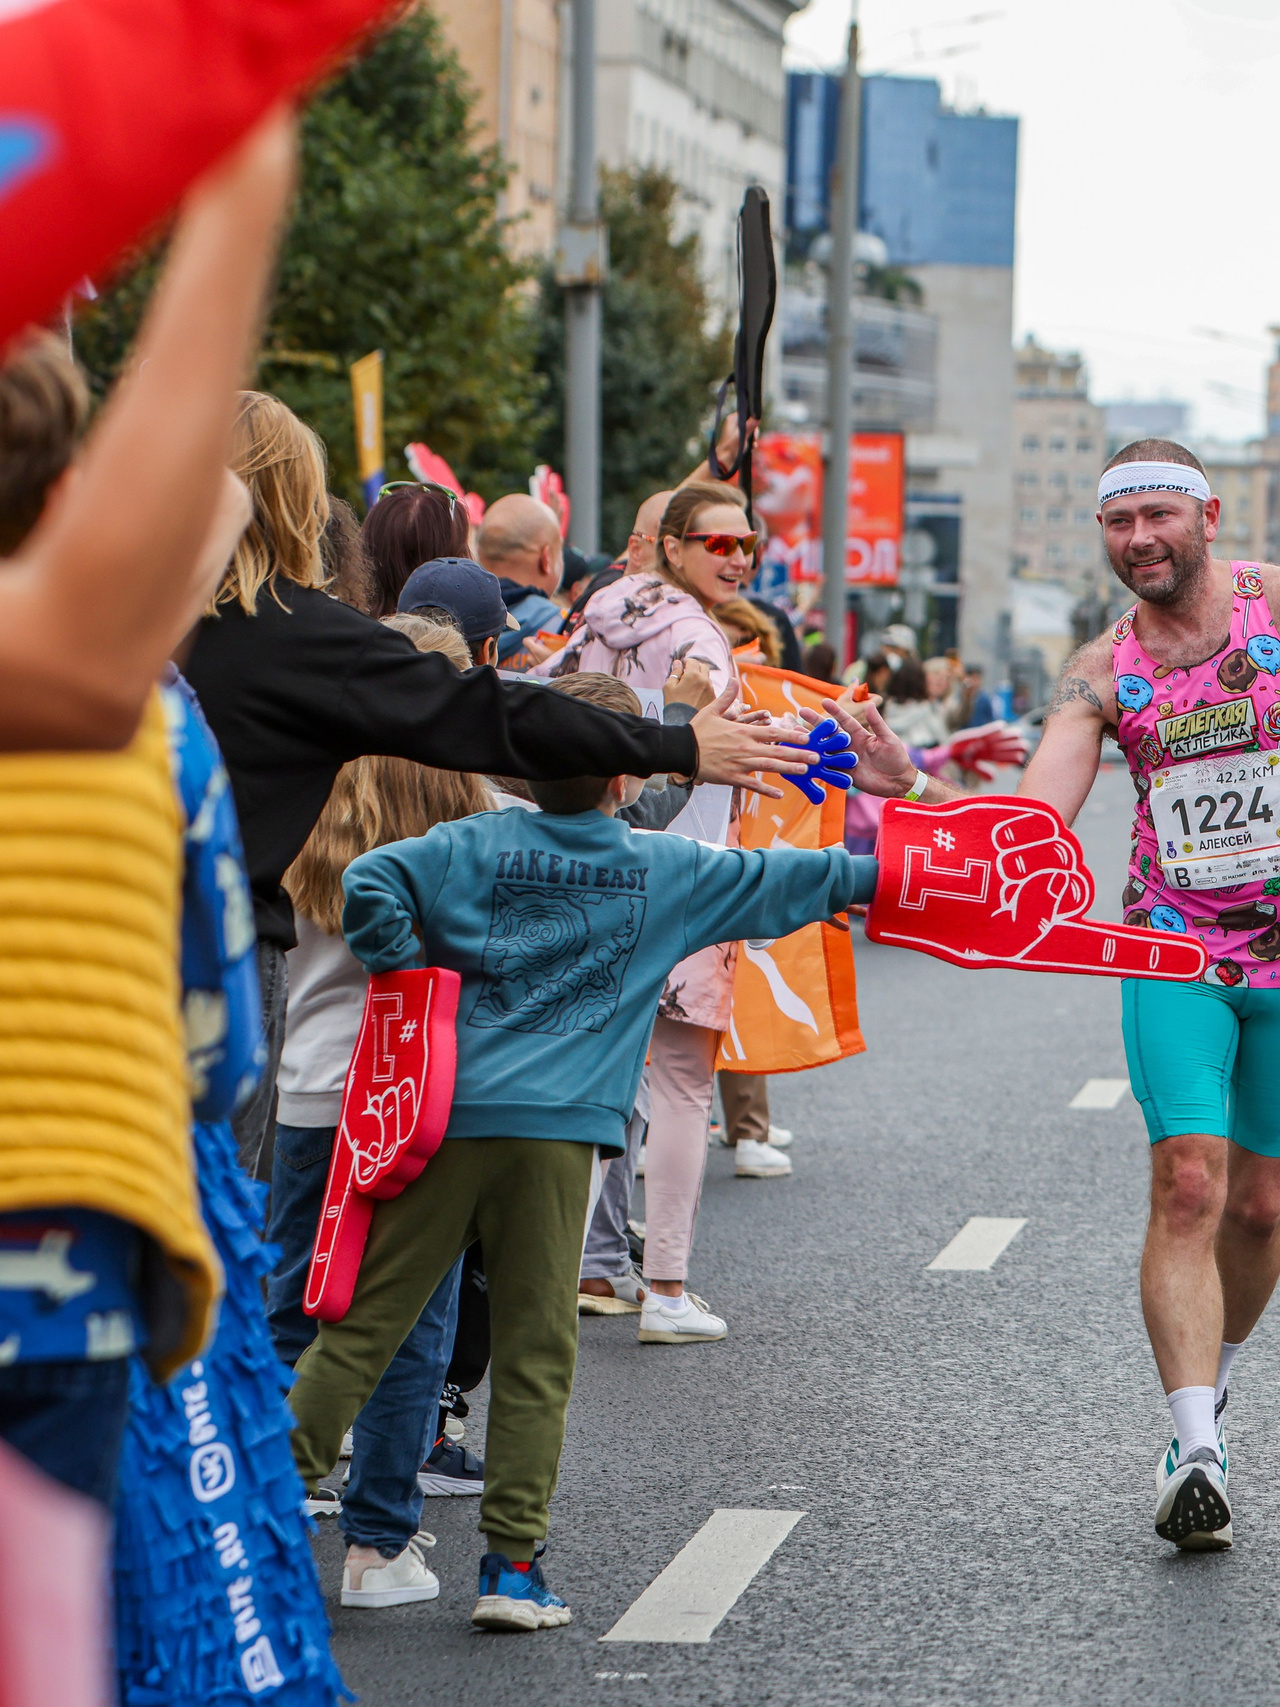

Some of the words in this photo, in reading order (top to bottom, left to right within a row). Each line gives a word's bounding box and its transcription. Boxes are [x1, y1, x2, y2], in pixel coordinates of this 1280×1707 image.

[1165, 701, 1248, 746] НЕЛЕГКАЯ
[1174, 727, 1250, 756] АТЛЕТИКА
[1216, 769, 1247, 785] 42,2
[1171, 785, 1274, 836] 1224
[1199, 830, 1253, 851] АЛЕКСЕЙ
[495, 849, 563, 884] TAKE
[565, 859, 591, 886] IT
[593, 866, 649, 892] EASY
